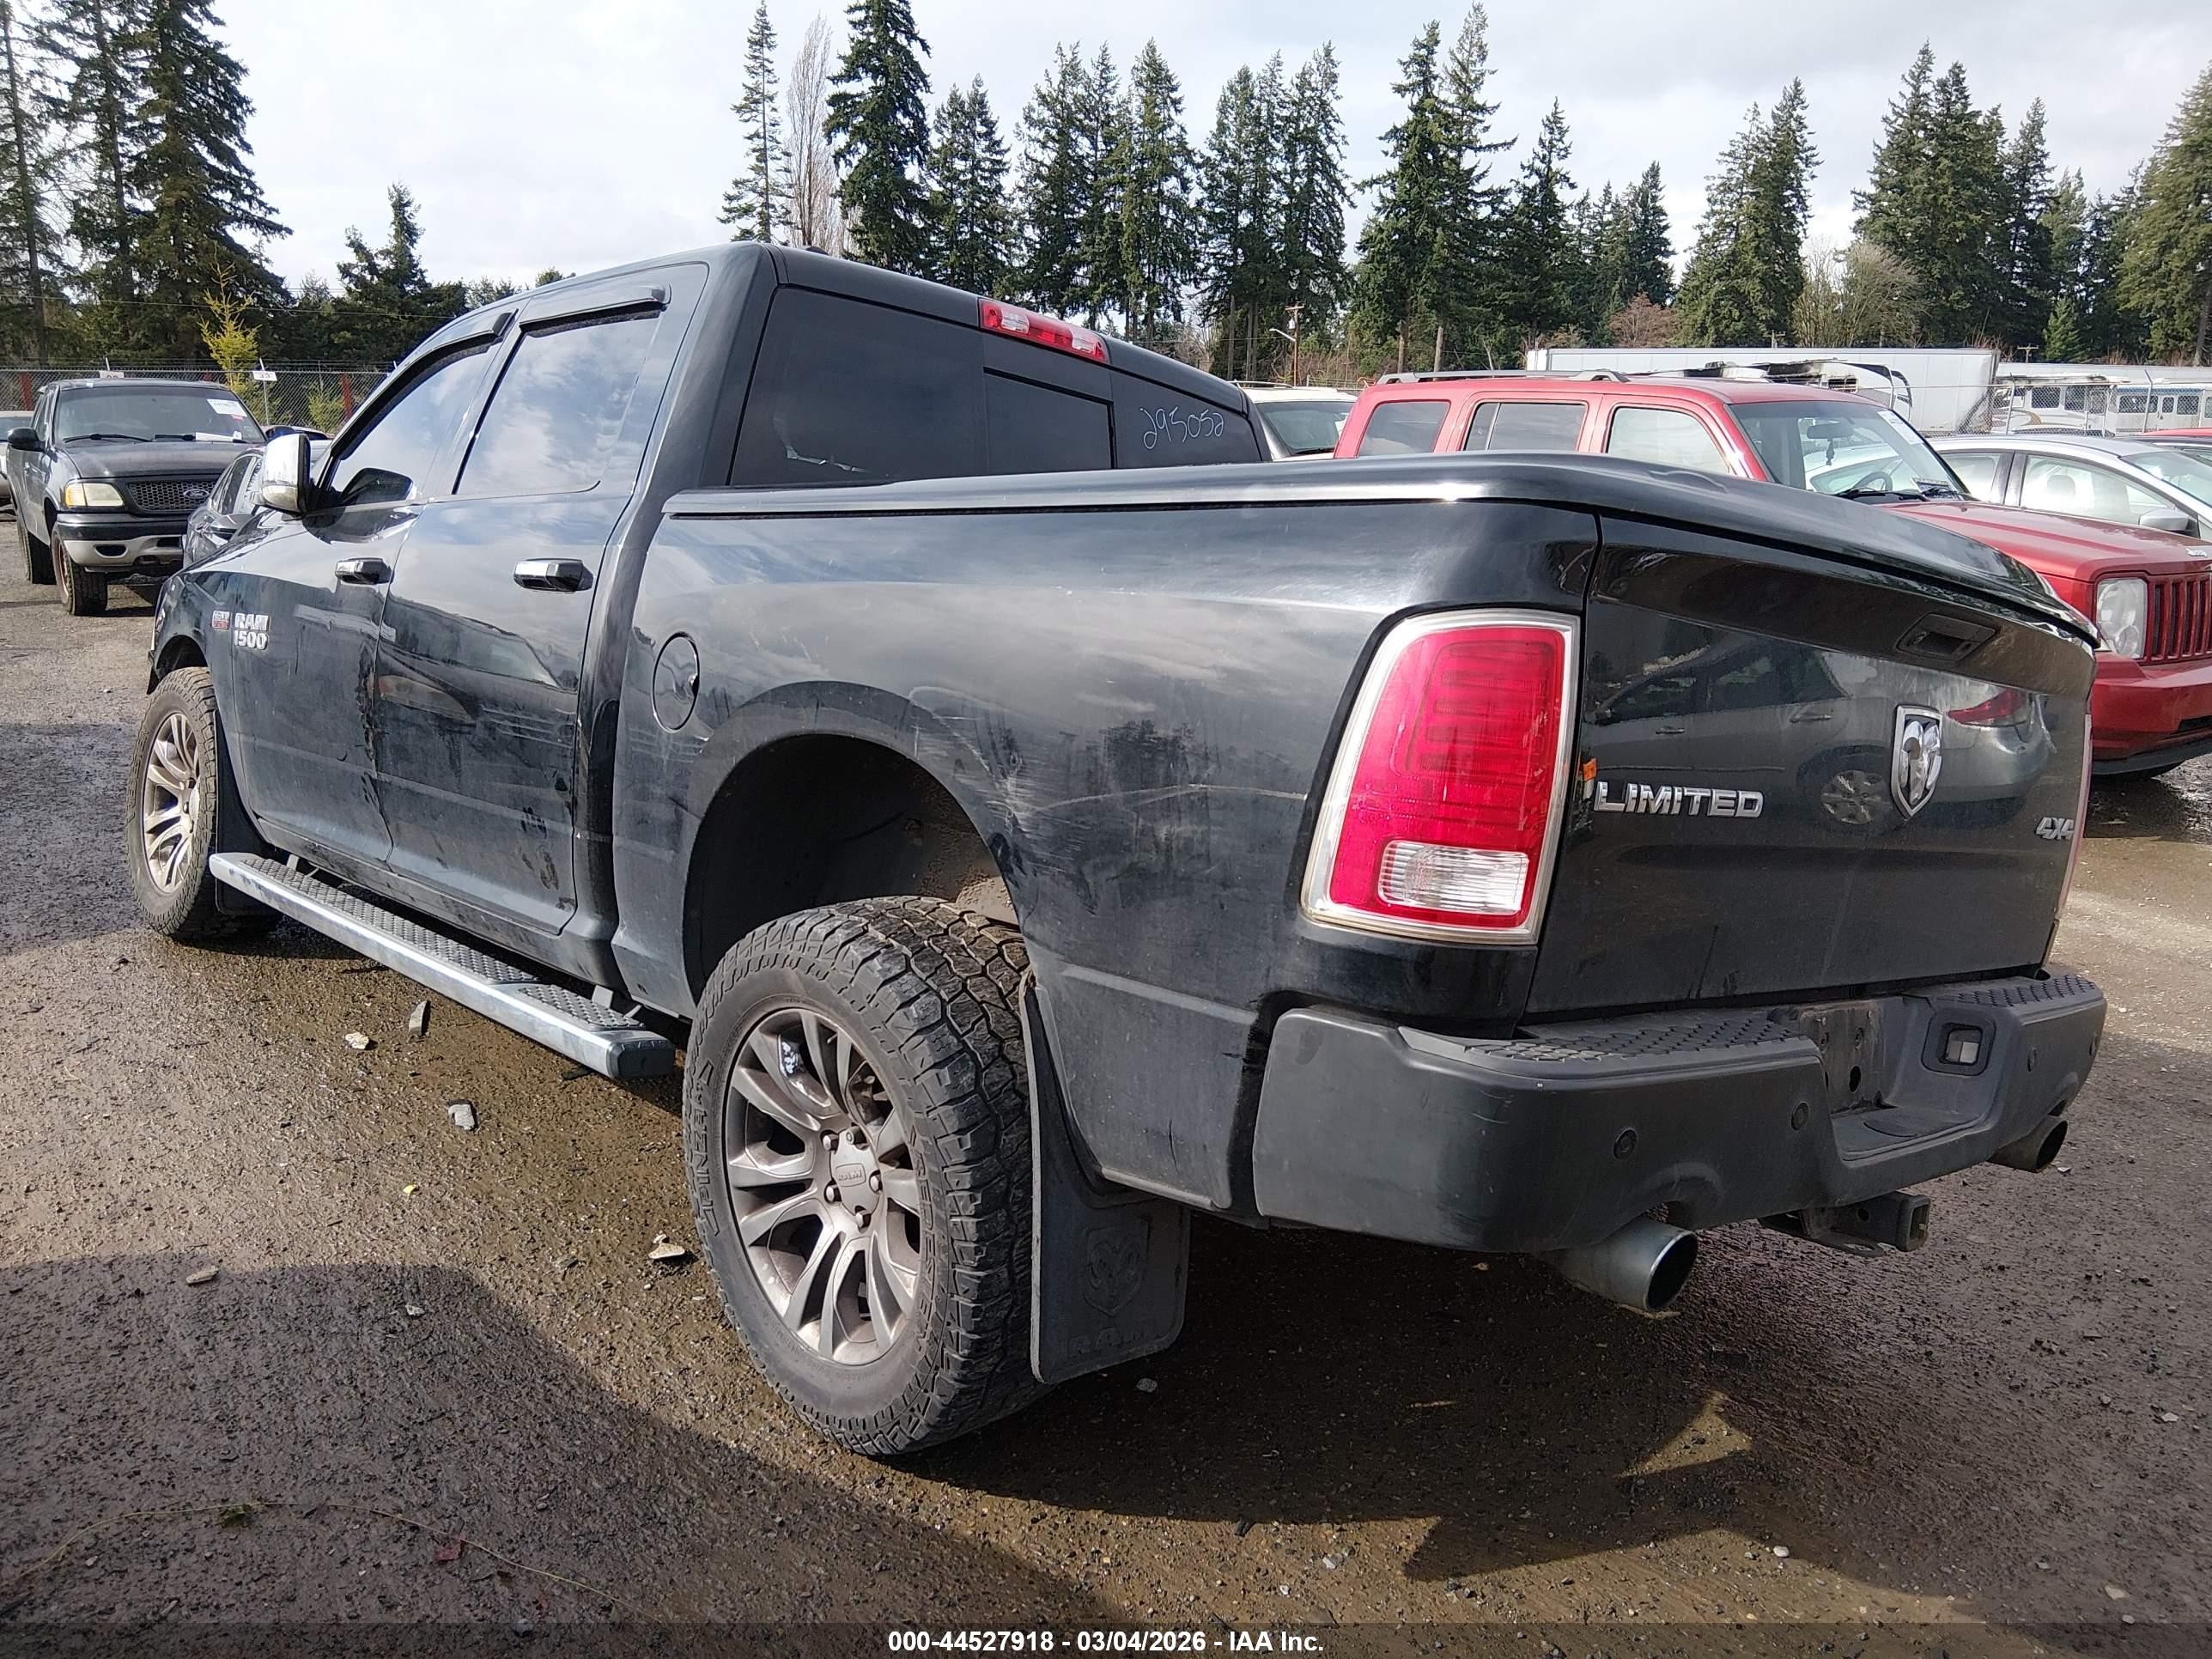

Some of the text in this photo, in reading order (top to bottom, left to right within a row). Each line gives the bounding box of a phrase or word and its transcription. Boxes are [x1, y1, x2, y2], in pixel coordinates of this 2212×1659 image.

[1139, 406, 1224, 449] 295052
[234, 612, 269, 631] RAM
[234, 629, 269, 650] 1500
[1594, 781, 1764, 818] LIMITED
[694, 1108, 713, 1212] PINZA
